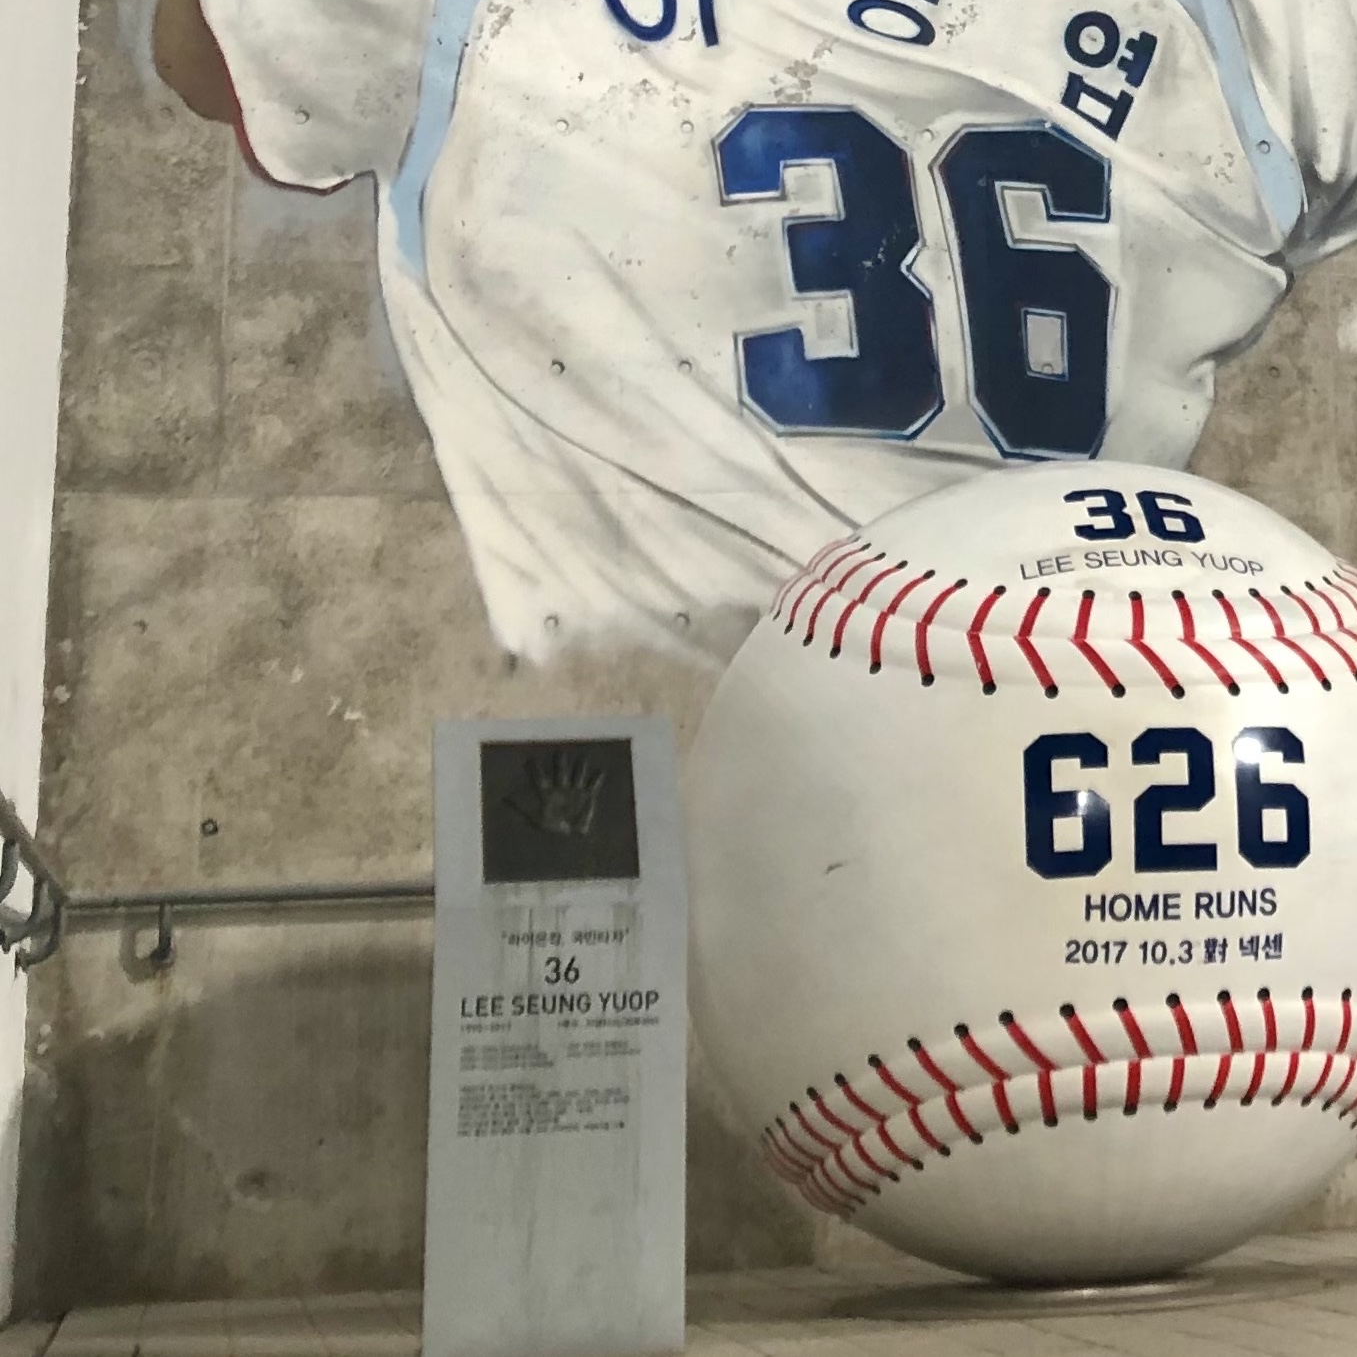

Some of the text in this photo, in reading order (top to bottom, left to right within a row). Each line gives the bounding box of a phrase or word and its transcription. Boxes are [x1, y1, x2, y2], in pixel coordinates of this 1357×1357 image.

[711, 103, 1118, 460] 36
[1063, 488, 1206, 544] 36
[1020, 549, 1264, 581] LEE SEUNG YUOP
[1023, 726, 1311, 880] 626
[1084, 888, 1277, 922] HOME RUNS
[1065, 940, 1127, 964] 2017
[1139, 940, 1193, 964] 10.3
[1239, 933, 1283, 961] 넥센
[545, 955, 580, 984] 36
[461, 990, 660, 1017] LEE SEUNG YUOP
